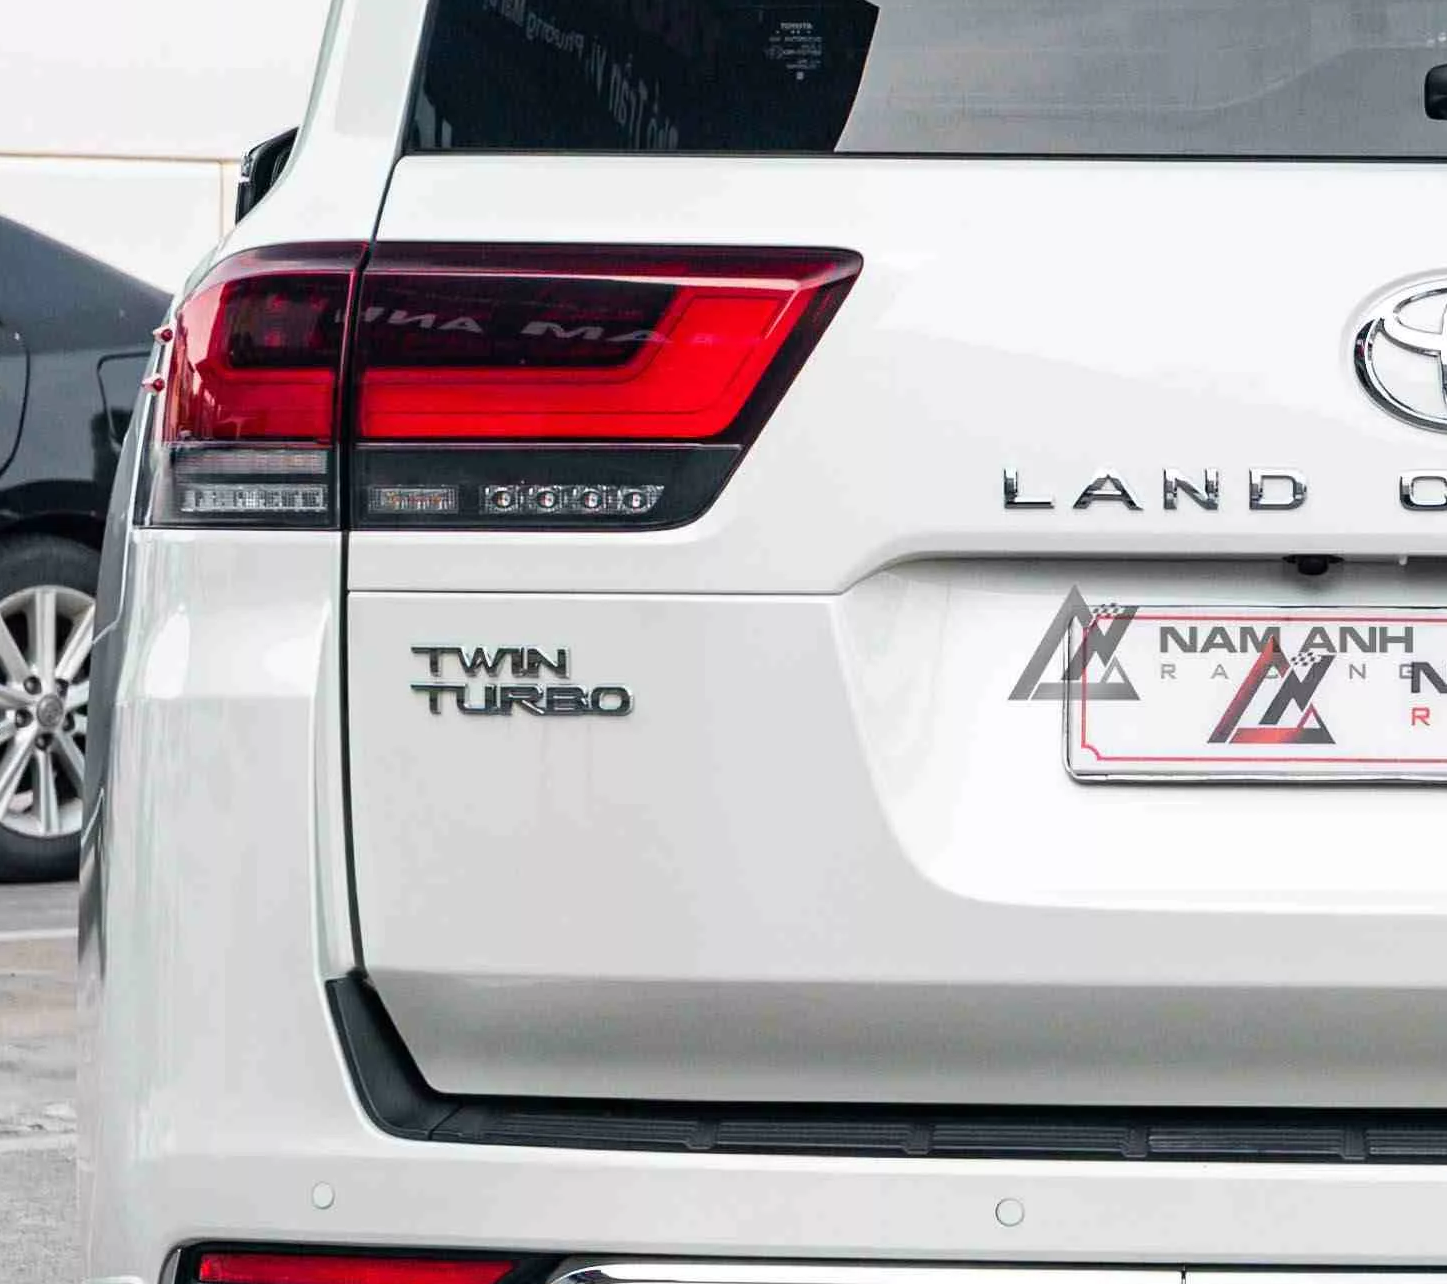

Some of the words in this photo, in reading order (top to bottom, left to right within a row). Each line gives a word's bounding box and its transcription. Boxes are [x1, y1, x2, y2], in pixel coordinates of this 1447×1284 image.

[1003, 467, 1308, 510] LAND
[410, 645, 570, 678] TWIN
[410, 682, 636, 717] TURBO
